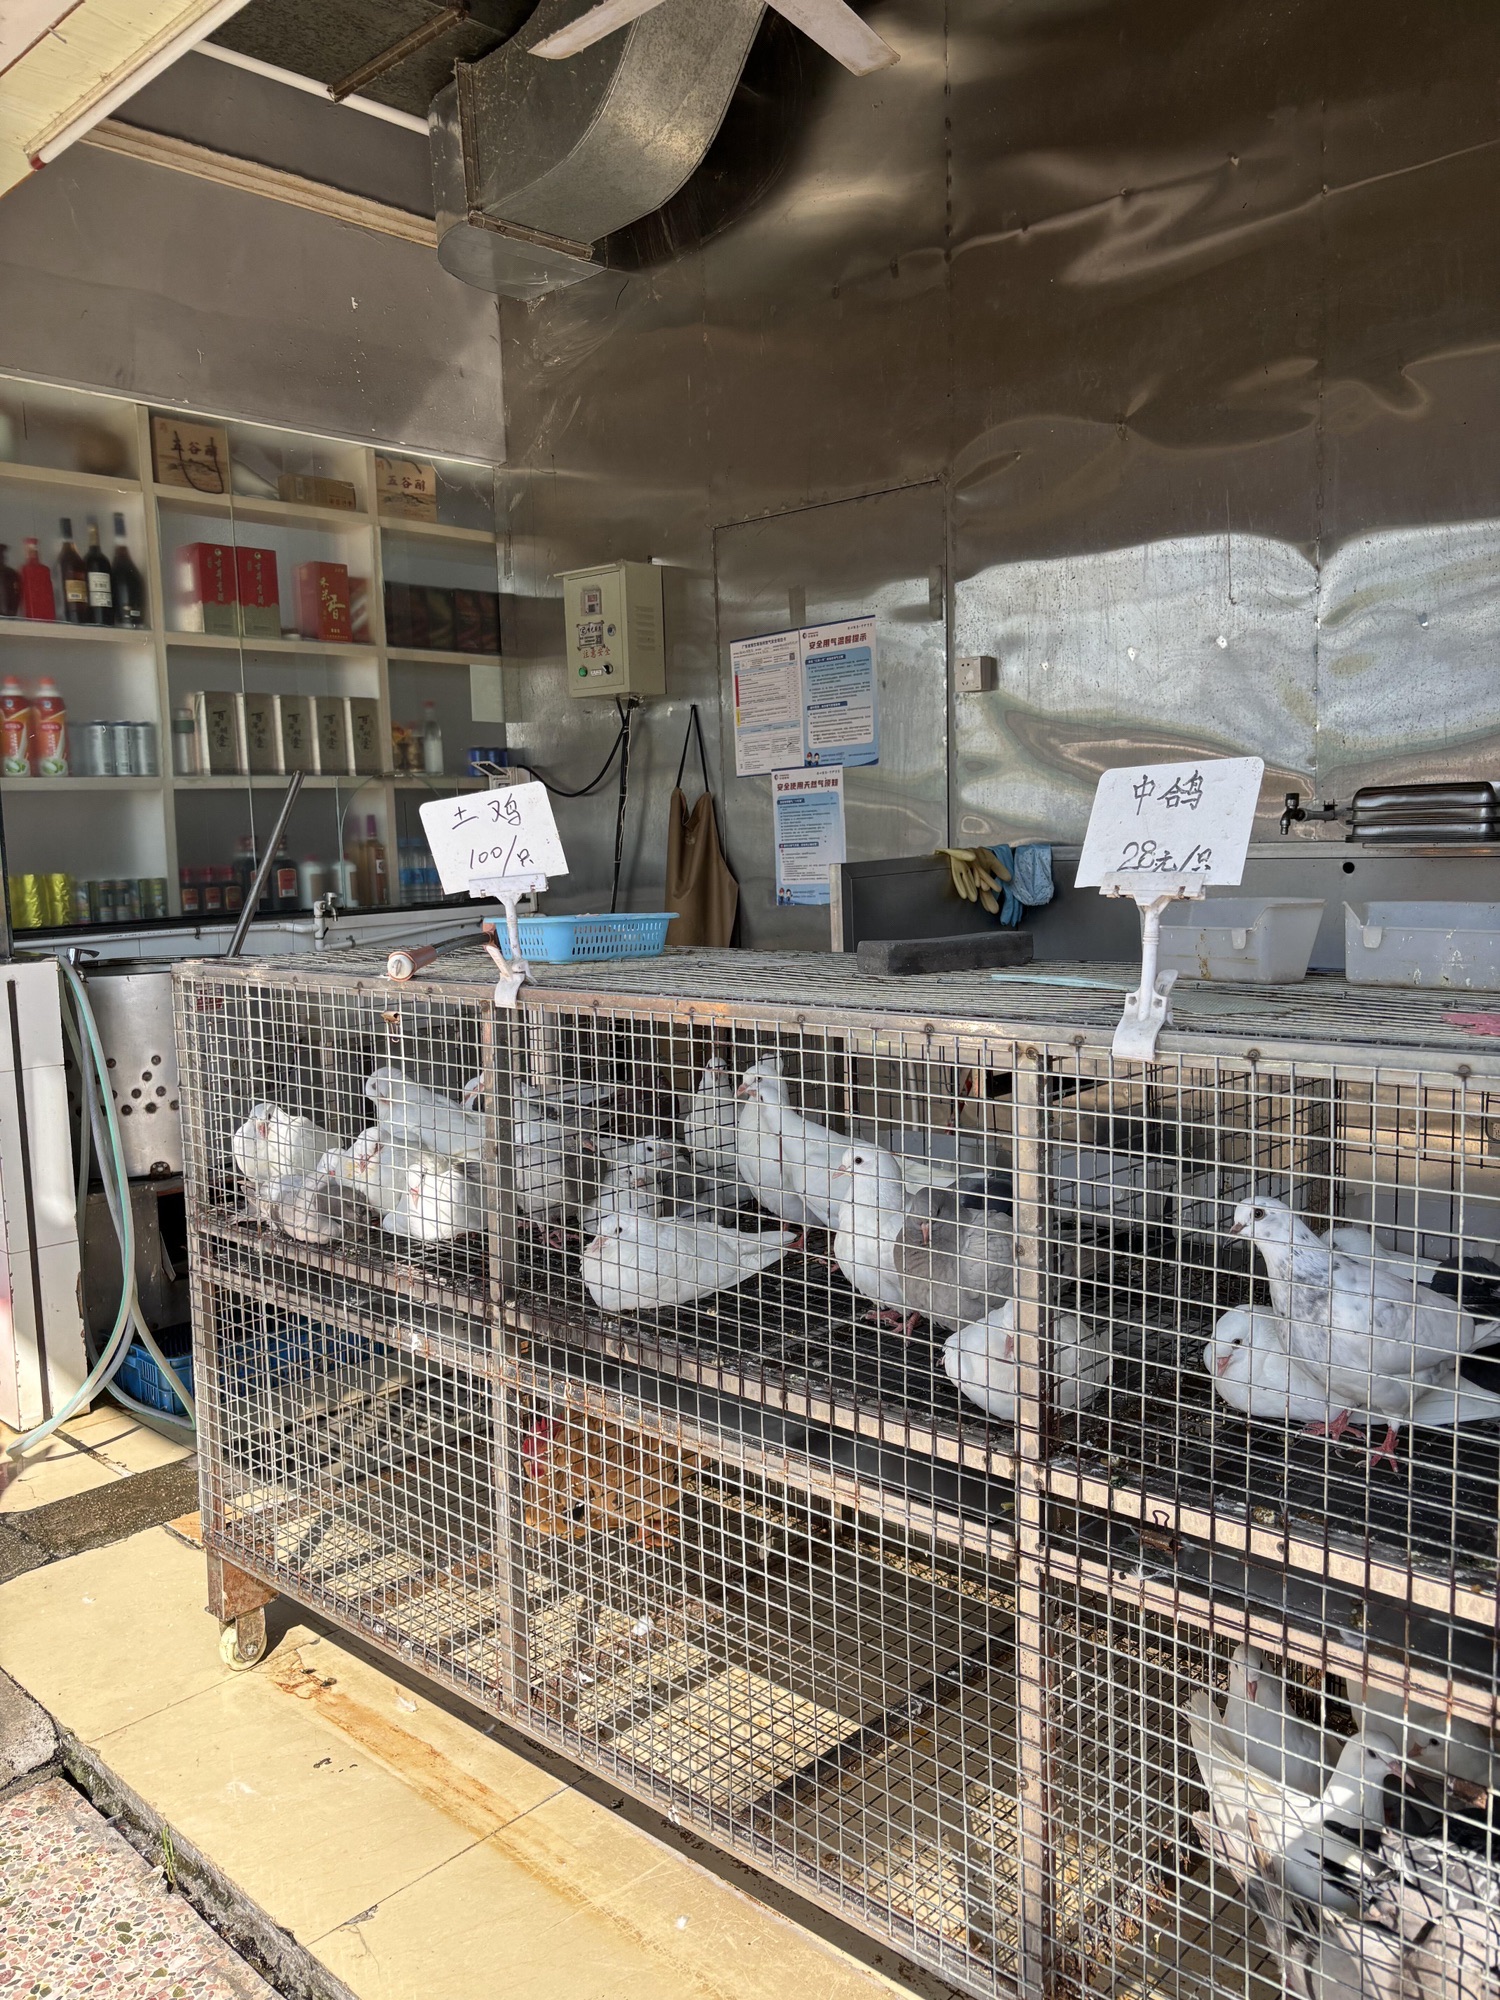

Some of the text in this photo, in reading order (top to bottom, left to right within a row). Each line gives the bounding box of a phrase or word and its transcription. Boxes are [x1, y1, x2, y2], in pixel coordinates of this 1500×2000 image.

[583, 646, 610, 659] 注意安全
[809, 632, 867, 650] 安全用气温馨提示
[777, 778, 839, 791] 安全使用天然气须知
[1132, 769, 1204, 816] 中鸽
[451, 793, 522, 830] 土鸡
[1116, 839, 1212, 873] 28元/只
